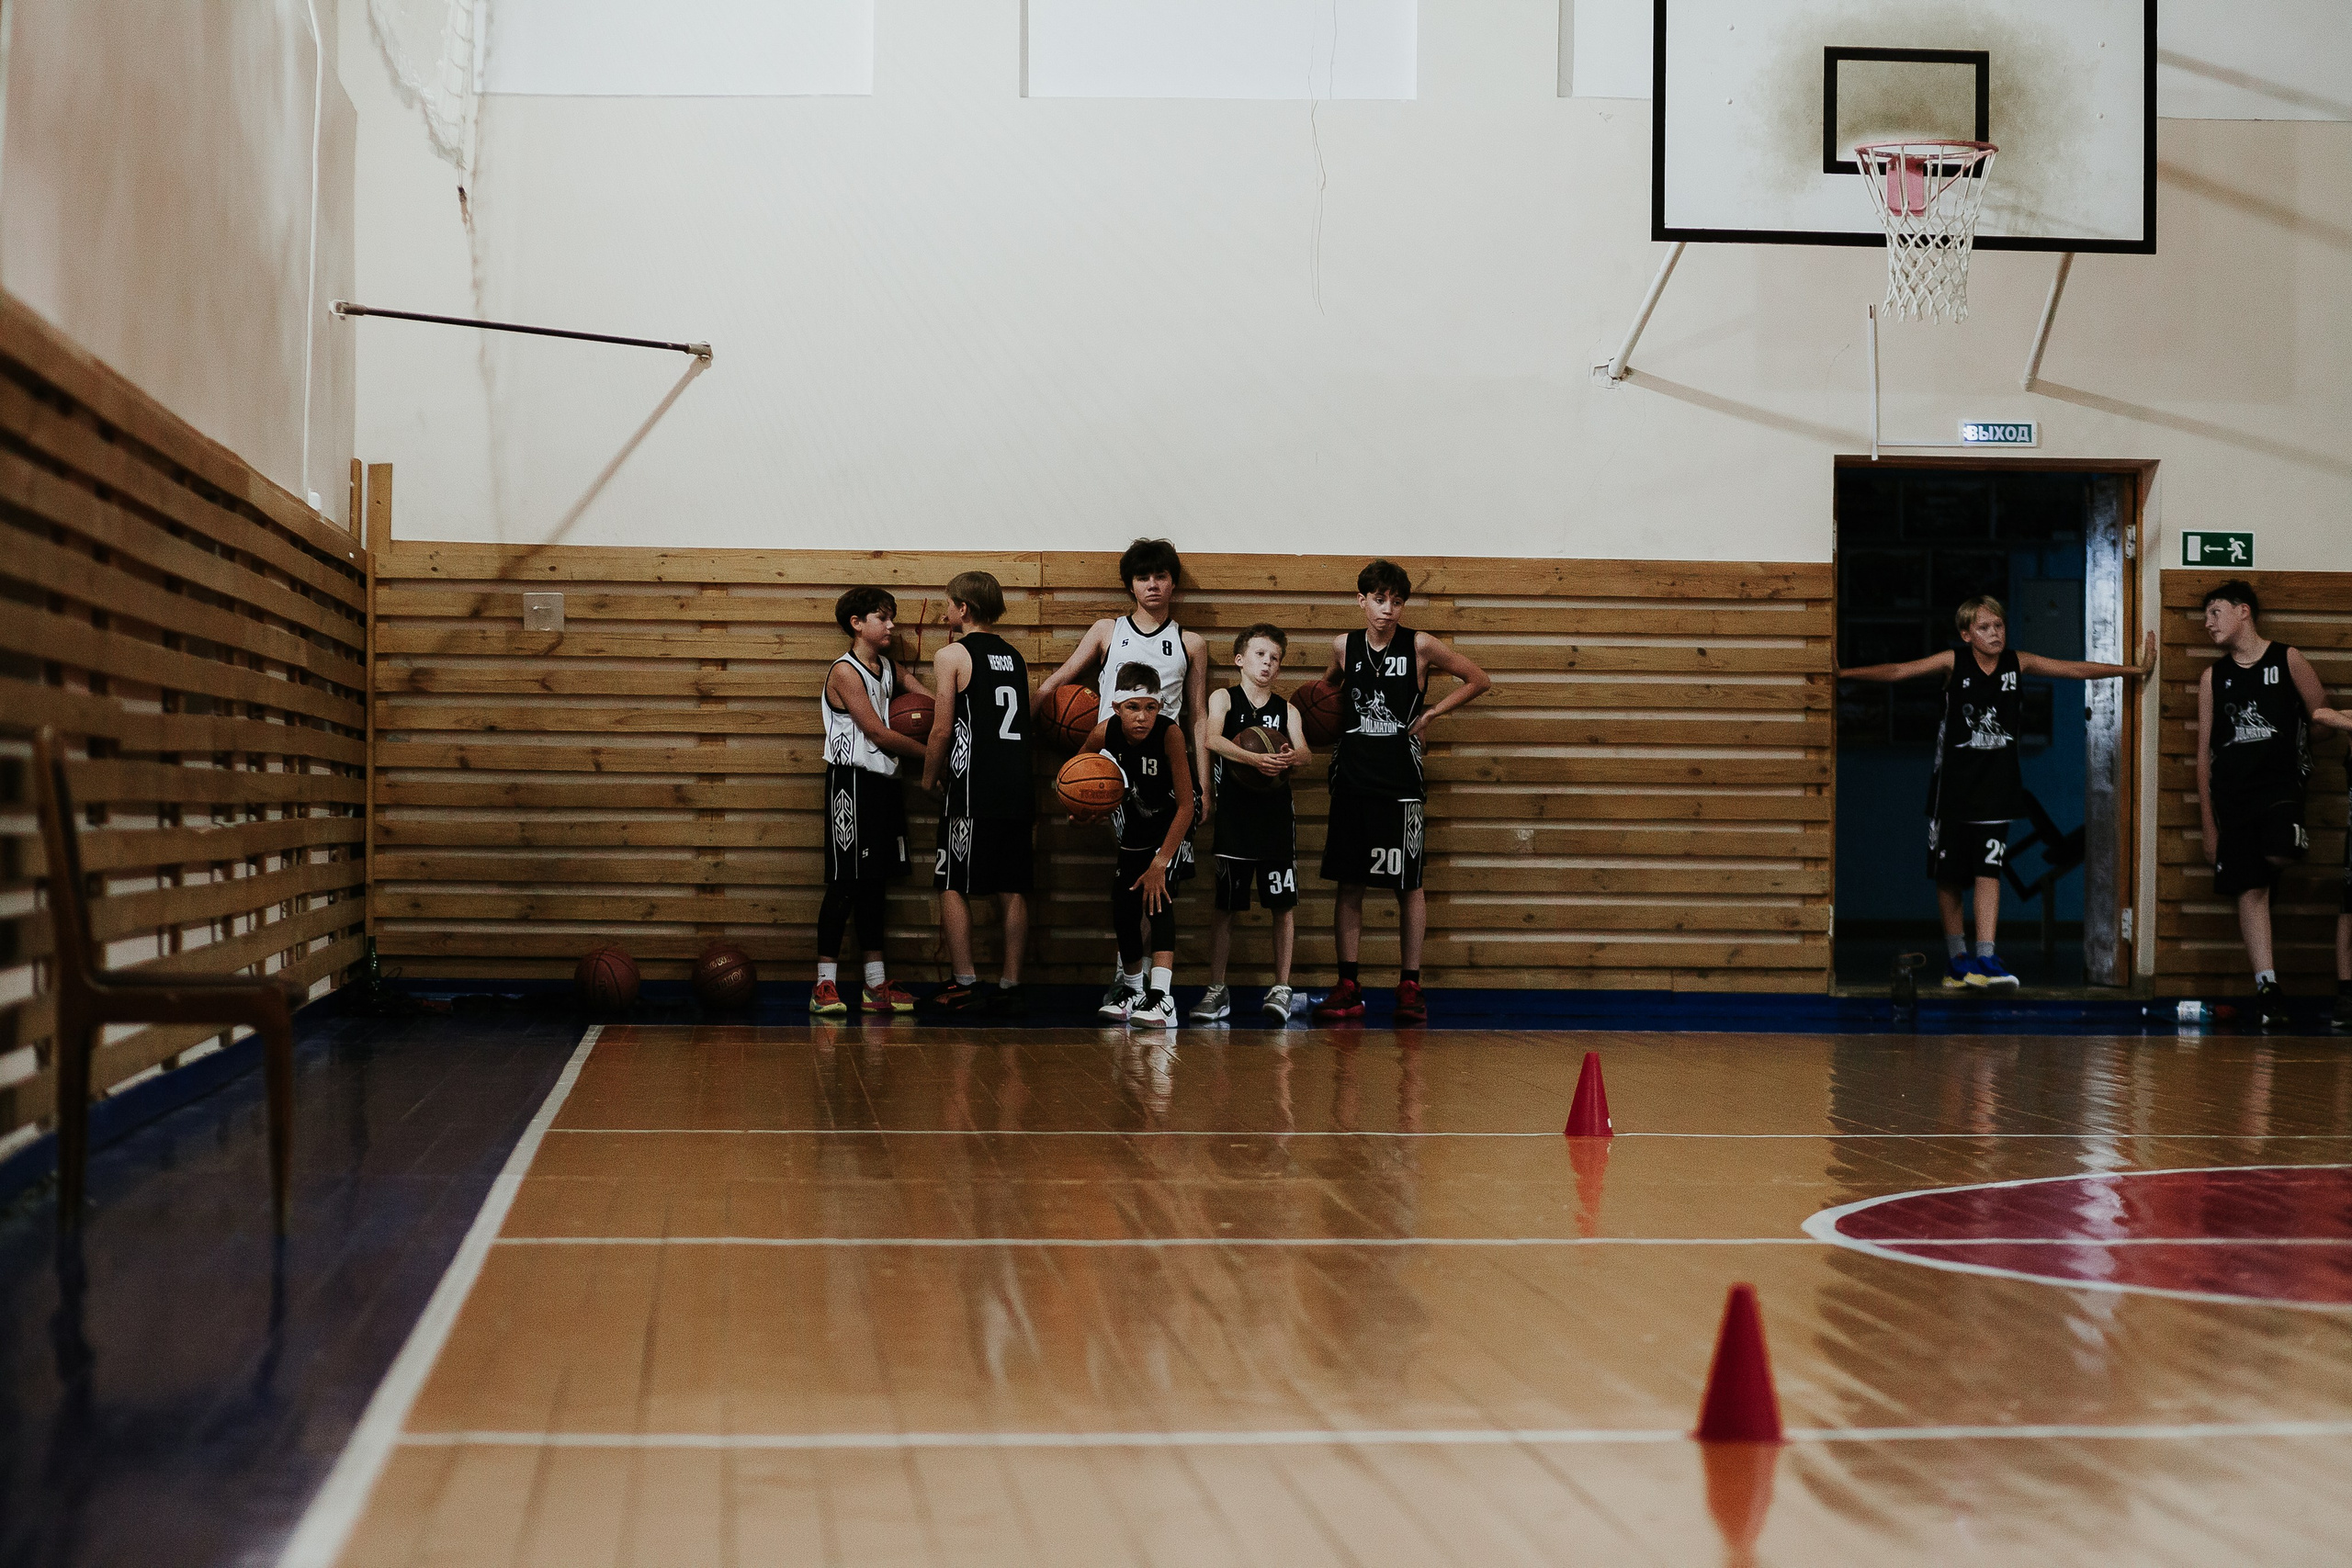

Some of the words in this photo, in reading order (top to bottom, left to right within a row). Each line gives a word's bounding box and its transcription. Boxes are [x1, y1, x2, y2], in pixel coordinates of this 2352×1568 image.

[1964, 425, 2030, 442] ВЫХОД
[1162, 640, 1172, 656] 8
[1385, 656, 1408, 677] 20
[2264, 666, 2279, 685] 10
[2001, 671, 2017, 691] 29
[995, 686, 1021, 740] 2
[1262, 715, 1280, 731] 34
[1360, 715, 1396, 733] DOLMATON
[1142, 757, 1158, 775] 13
[934, 849, 946, 875] 2
[1370, 848, 1402, 874] 20
[1268, 868, 1295, 894] 34
